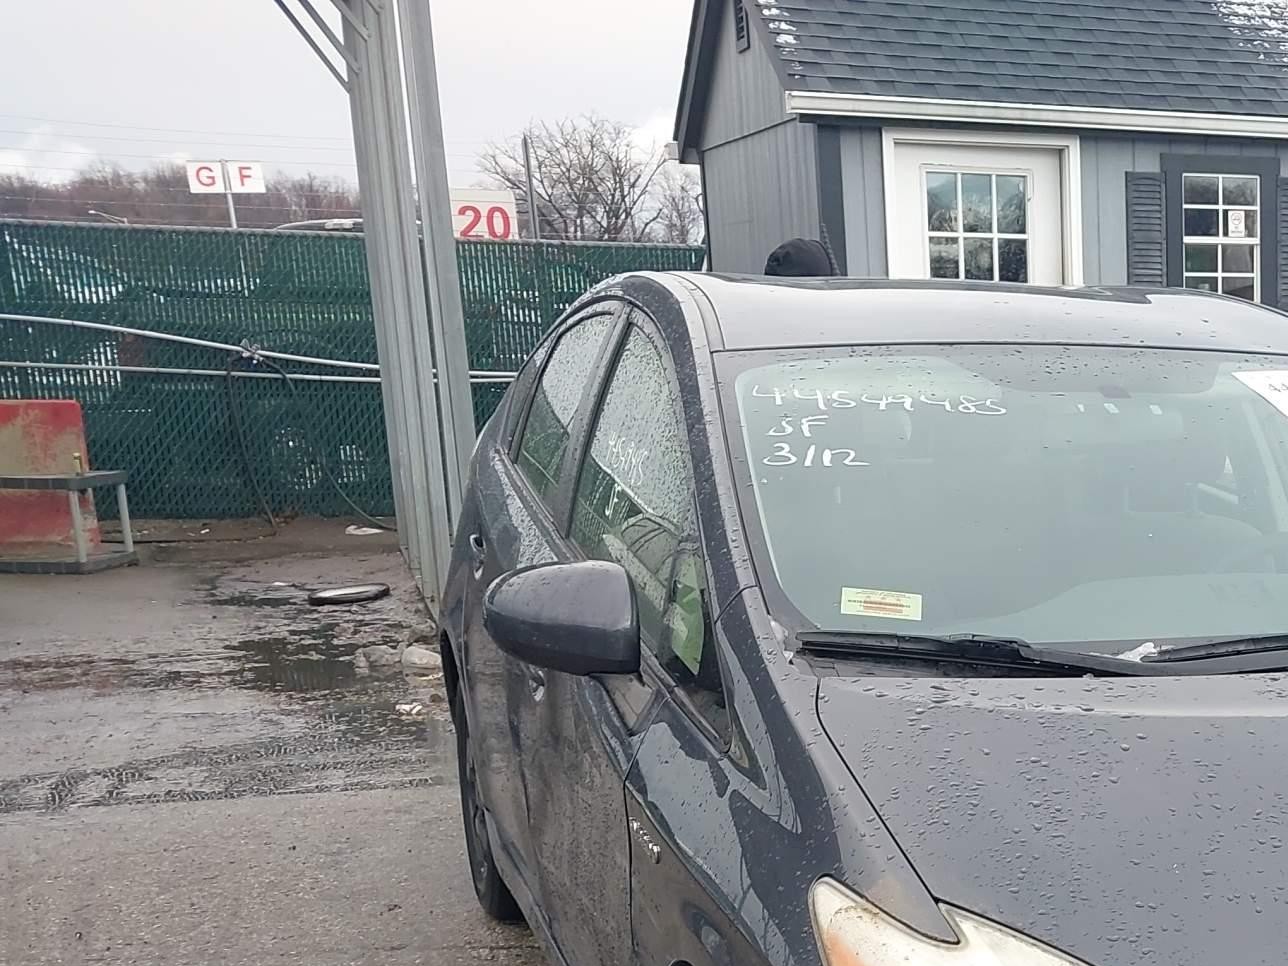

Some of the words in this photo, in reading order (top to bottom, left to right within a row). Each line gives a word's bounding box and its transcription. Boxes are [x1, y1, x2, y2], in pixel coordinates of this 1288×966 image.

[195, 166, 217, 187] G
[237, 166, 253, 187] F
[457, 205, 511, 239] 20
[751, 384, 1008, 415] 44549485
[762, 442, 871, 467] 3/12
